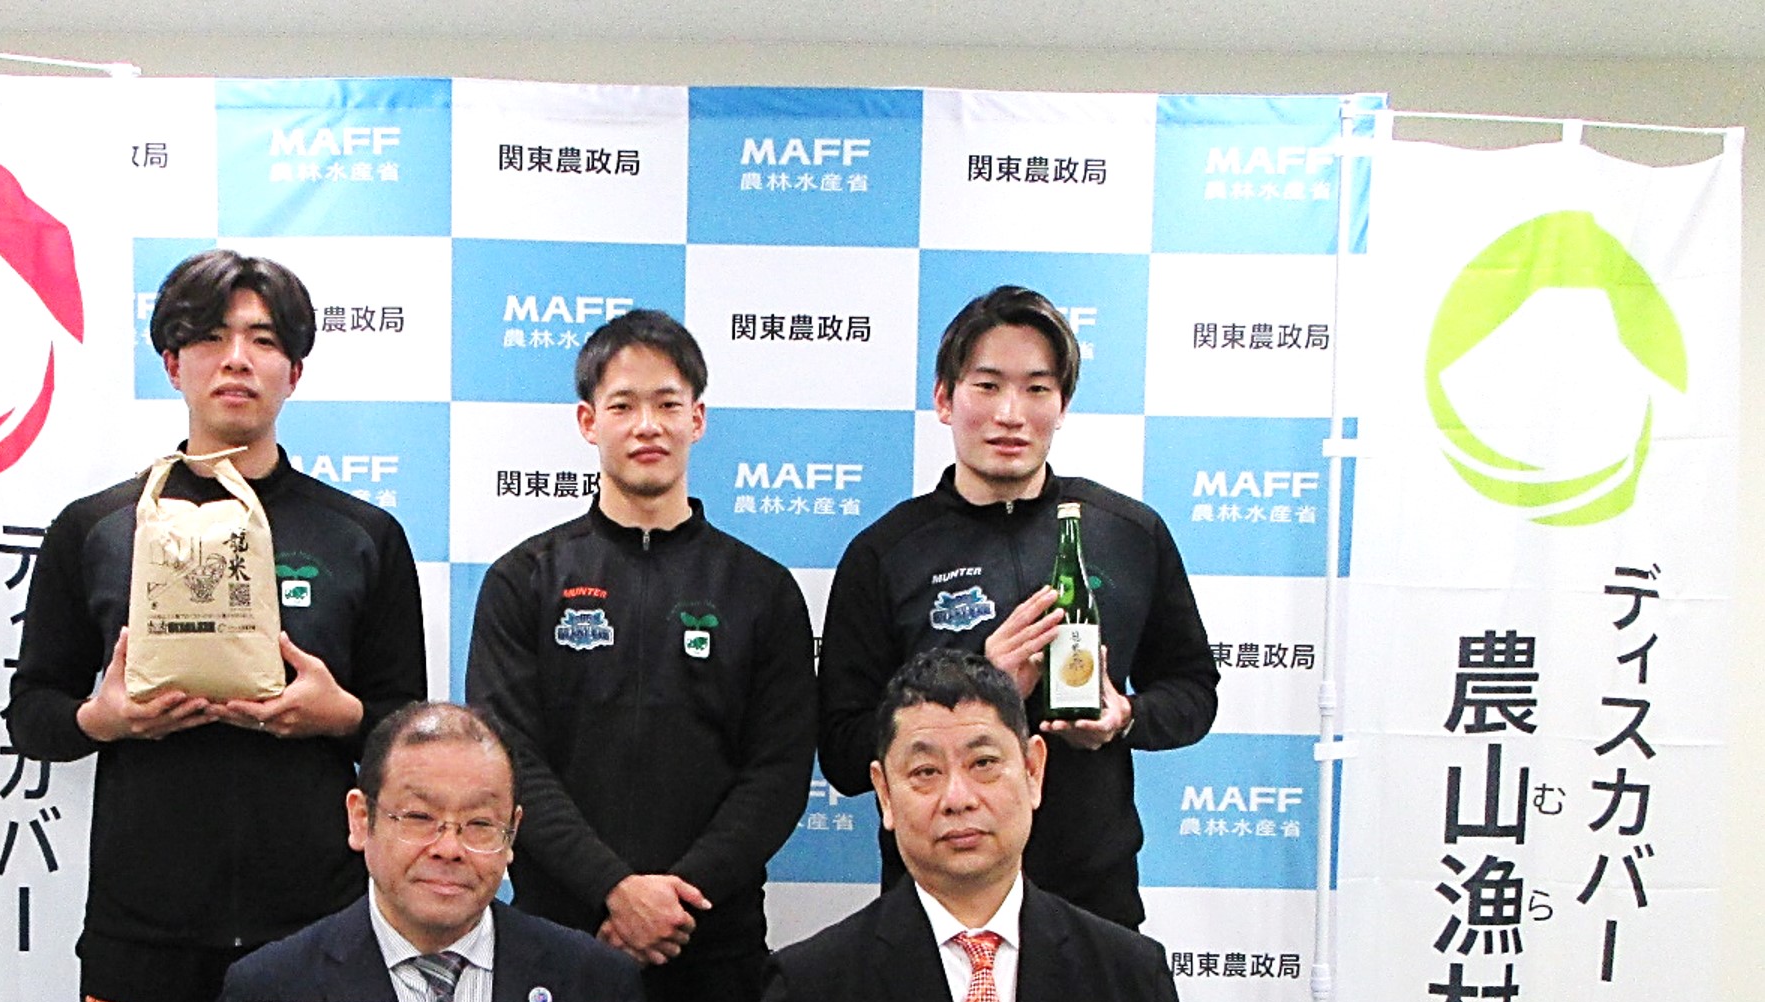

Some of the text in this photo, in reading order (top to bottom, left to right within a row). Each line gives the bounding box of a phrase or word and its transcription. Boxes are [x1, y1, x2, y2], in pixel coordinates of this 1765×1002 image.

[269, 126, 401, 157] MAFF
[741, 137, 872, 166] MAFF
[269, 163, 400, 183] 農林水産省
[498, 143, 641, 176] 関東農政局
[967, 154, 1107, 186] 関東農政局
[1205, 146, 1333, 175] MAFF
[740, 172, 869, 193] 農林水産省
[1204, 179, 1331, 201] 農林水産省
[314, 305, 405, 334] 農政局
[731, 313, 872, 343] 関東農政局
[503, 328, 594, 349] 農林水
[1193, 322, 1330, 350] 関東農政局
[291, 455, 400, 483] AFF
[735, 462, 864, 490] MAFF
[496, 470, 601, 498] 関東農政
[1191, 470, 1321, 498] MAFF
[734, 494, 862, 516] 農林水産省
[1191, 502, 1317, 524] 農林水産省
[1208, 643, 1315, 670] 東農政局
[1577, 562, 1662, 982] ディスカバー
[1181, 785, 1303, 813] MAFF
[1179, 818, 1301, 838] 農林水産省
[1527, 781, 1567, 924] むら
[1170, 953, 1301, 980] 関東農政局
